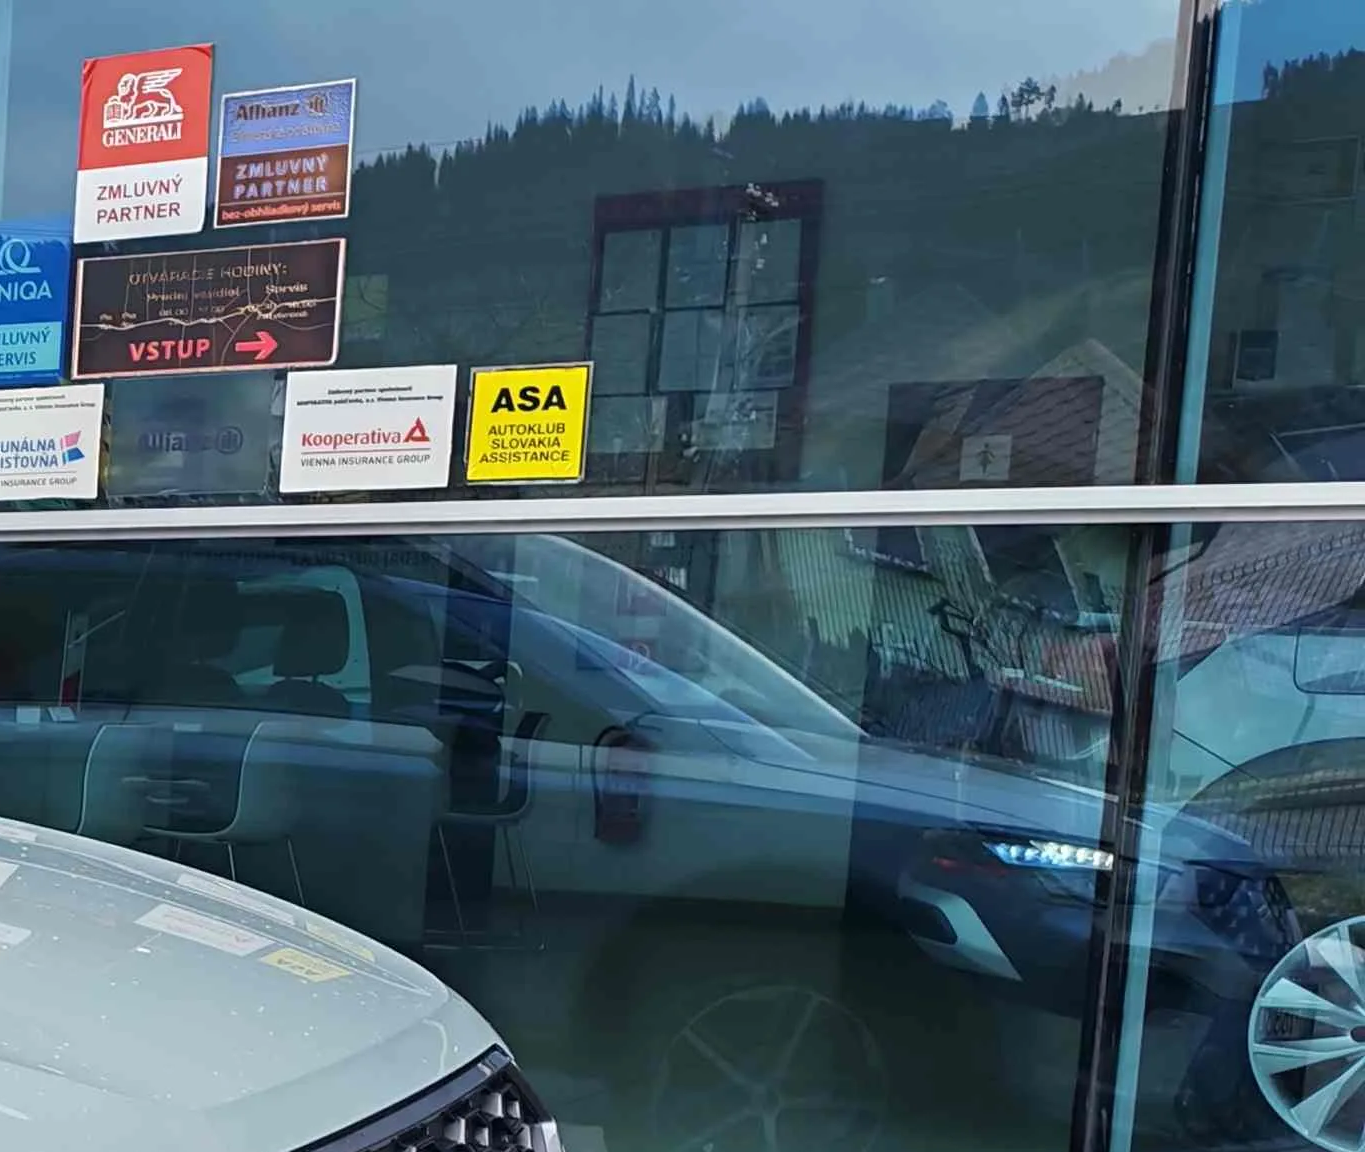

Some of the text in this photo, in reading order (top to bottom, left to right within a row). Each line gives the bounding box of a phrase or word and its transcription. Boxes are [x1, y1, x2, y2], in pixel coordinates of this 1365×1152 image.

[102, 122, 182, 148] GENERALI
[97, 173, 183, 201] ZMLUVNÝ
[233, 176, 327, 200] PARTNER
[96, 202, 181, 224] PARTNER
[128, 338, 211, 363] VSTUP
[490, 384, 567, 413] ASA
[301, 428, 401, 449] Kooperativa
[488, 422, 566, 436] AUTOKLUB
[491, 436, 561, 450] SLOVAKIA
[301, 454, 431, 467] VIENNA INSURANCE GROUP
[479, 450, 570, 464] ASSISTANCE
[1, 478, 47, 487] INSURANCE
[49, 477, 78, 485] GROUP
